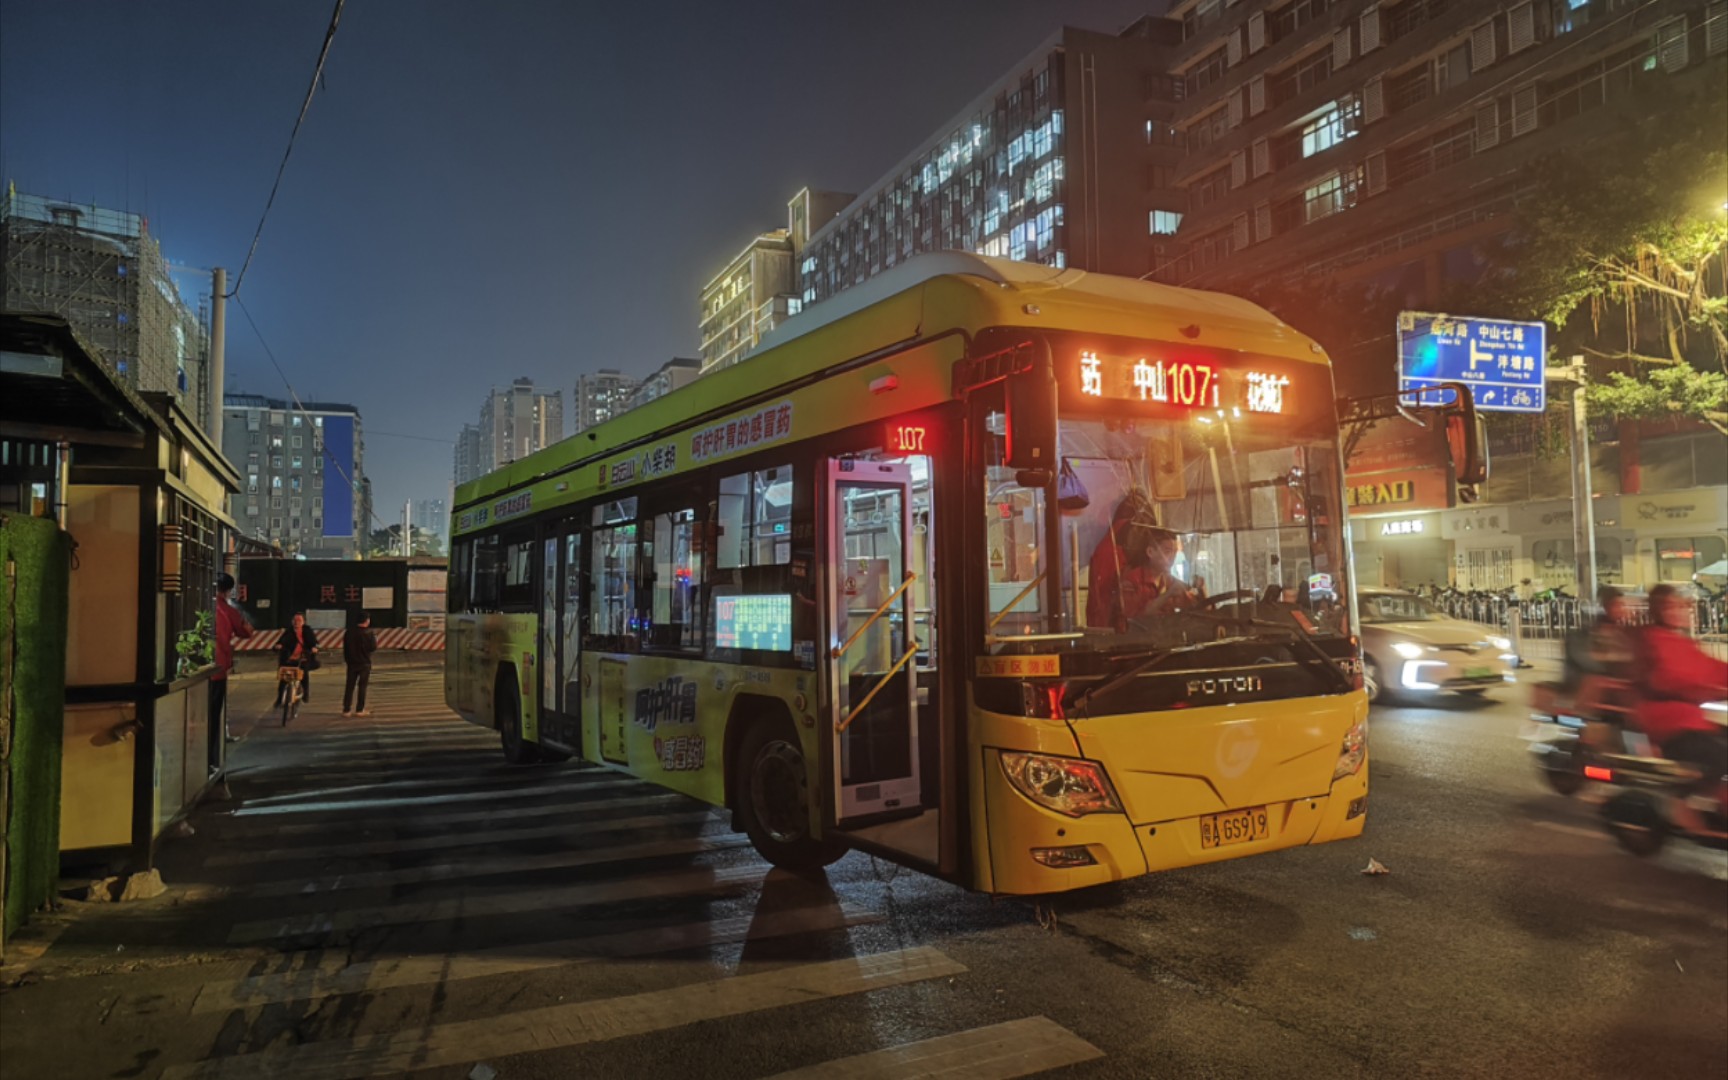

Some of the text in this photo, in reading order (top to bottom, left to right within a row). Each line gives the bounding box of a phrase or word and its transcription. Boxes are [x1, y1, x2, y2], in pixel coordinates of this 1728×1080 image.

[1479, 324, 1524, 342] 中山七路
[1080, 351, 1102, 397] 站
[1167, 362, 1211, 406] 107
[691, 404, 791, 459] 呵护肝胃的感冒药
[897, 426, 926, 451] 107
[641, 445, 677, 477] 小柴胡
[994, 660, 1056, 675] 盲区勿近
[1186, 675, 1262, 697] FOTON
[635, 676, 697, 730] 呵护肝胃
